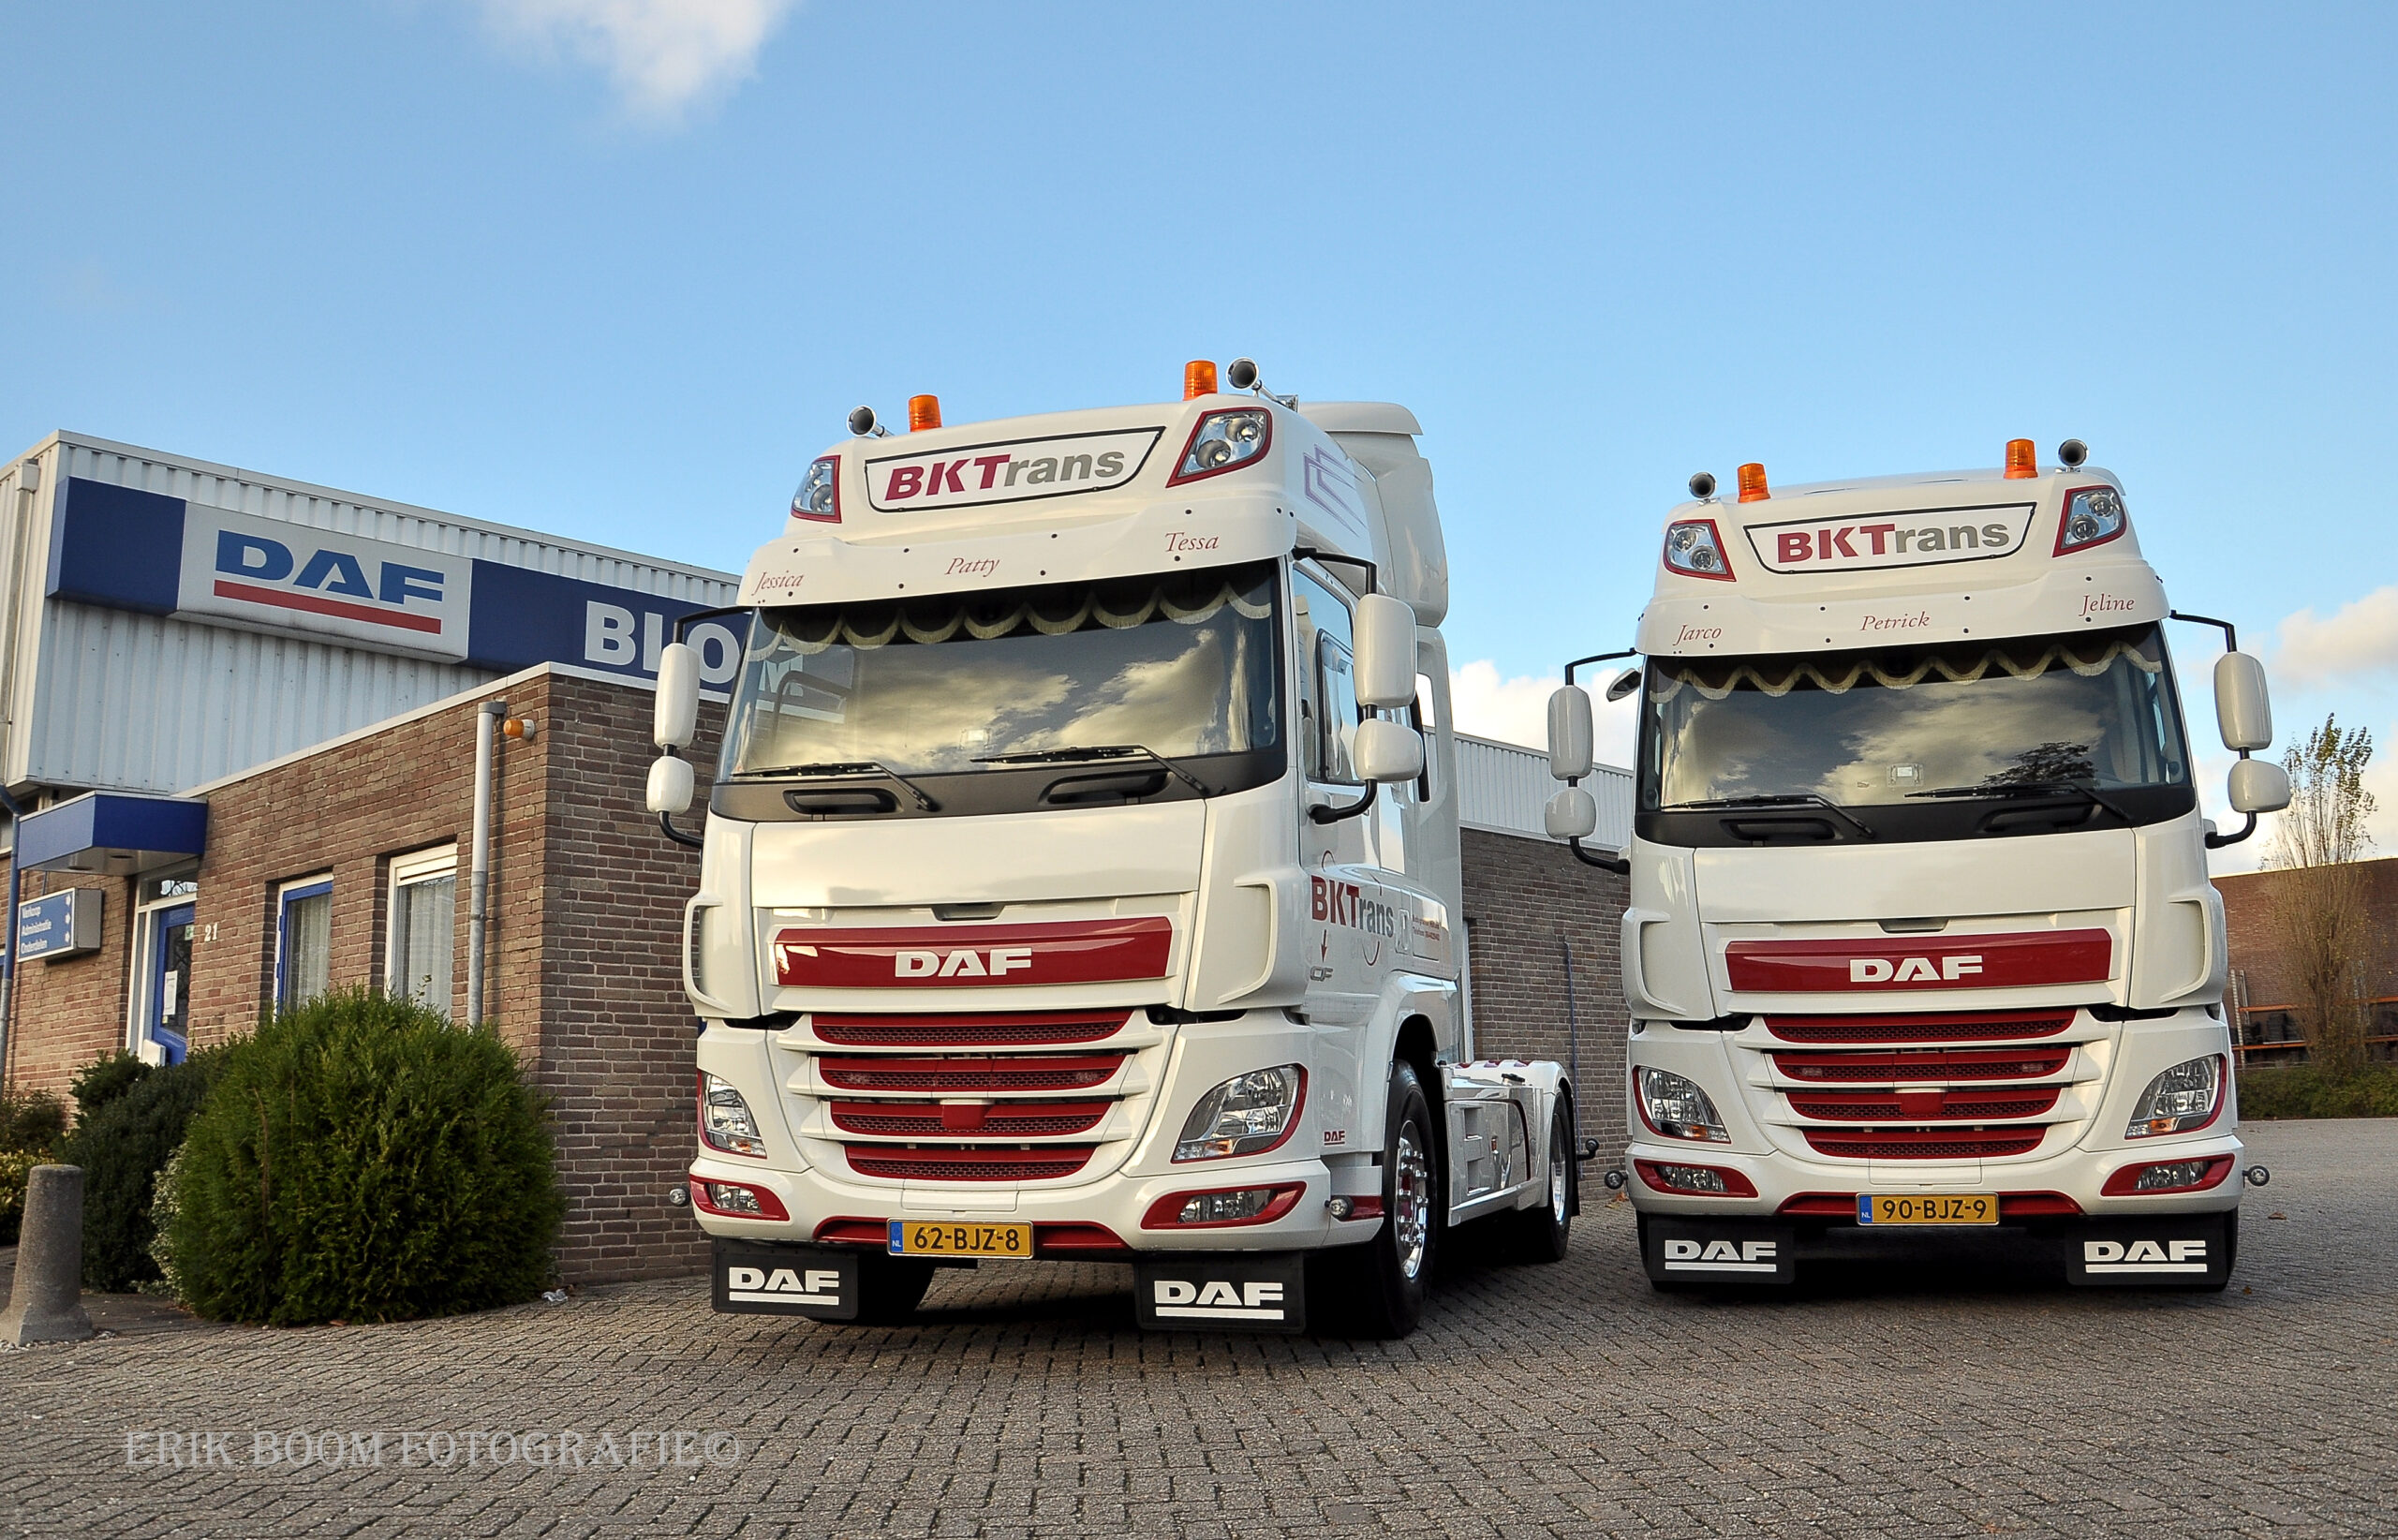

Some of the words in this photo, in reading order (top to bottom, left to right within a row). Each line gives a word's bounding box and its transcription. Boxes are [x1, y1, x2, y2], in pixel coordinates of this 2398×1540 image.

[885, 451, 1125, 501] BKTrans
[1164, 531, 1220, 554] Tessa
[1778, 522, 2009, 564] BKTrans
[214, 530, 445, 605] DAF
[944, 556, 1000, 577] Patty
[751, 569, 804, 597] Jessica
[2078, 593, 2135, 617] Jeline
[1860, 611, 1931, 633] Petrick
[1672, 623, 1722, 646] Jarco
[1311, 875, 1394, 938] BKTrans
[204, 923, 218, 941] 21
[895, 947, 1032, 978] DAF
[1850, 955, 1983, 983] DAF
[1324, 1130, 1345, 1142] DAF
[1882, 1199, 1987, 1220] 90-BJZ-9
[914, 1226, 1020, 1251] 62-BJZ-8
[1665, 1239, 1777, 1262] DAF
[2084, 1240, 2207, 1262] DAF
[729, 1267, 839, 1292] DAF
[1154, 1280, 1284, 1306] DAF
